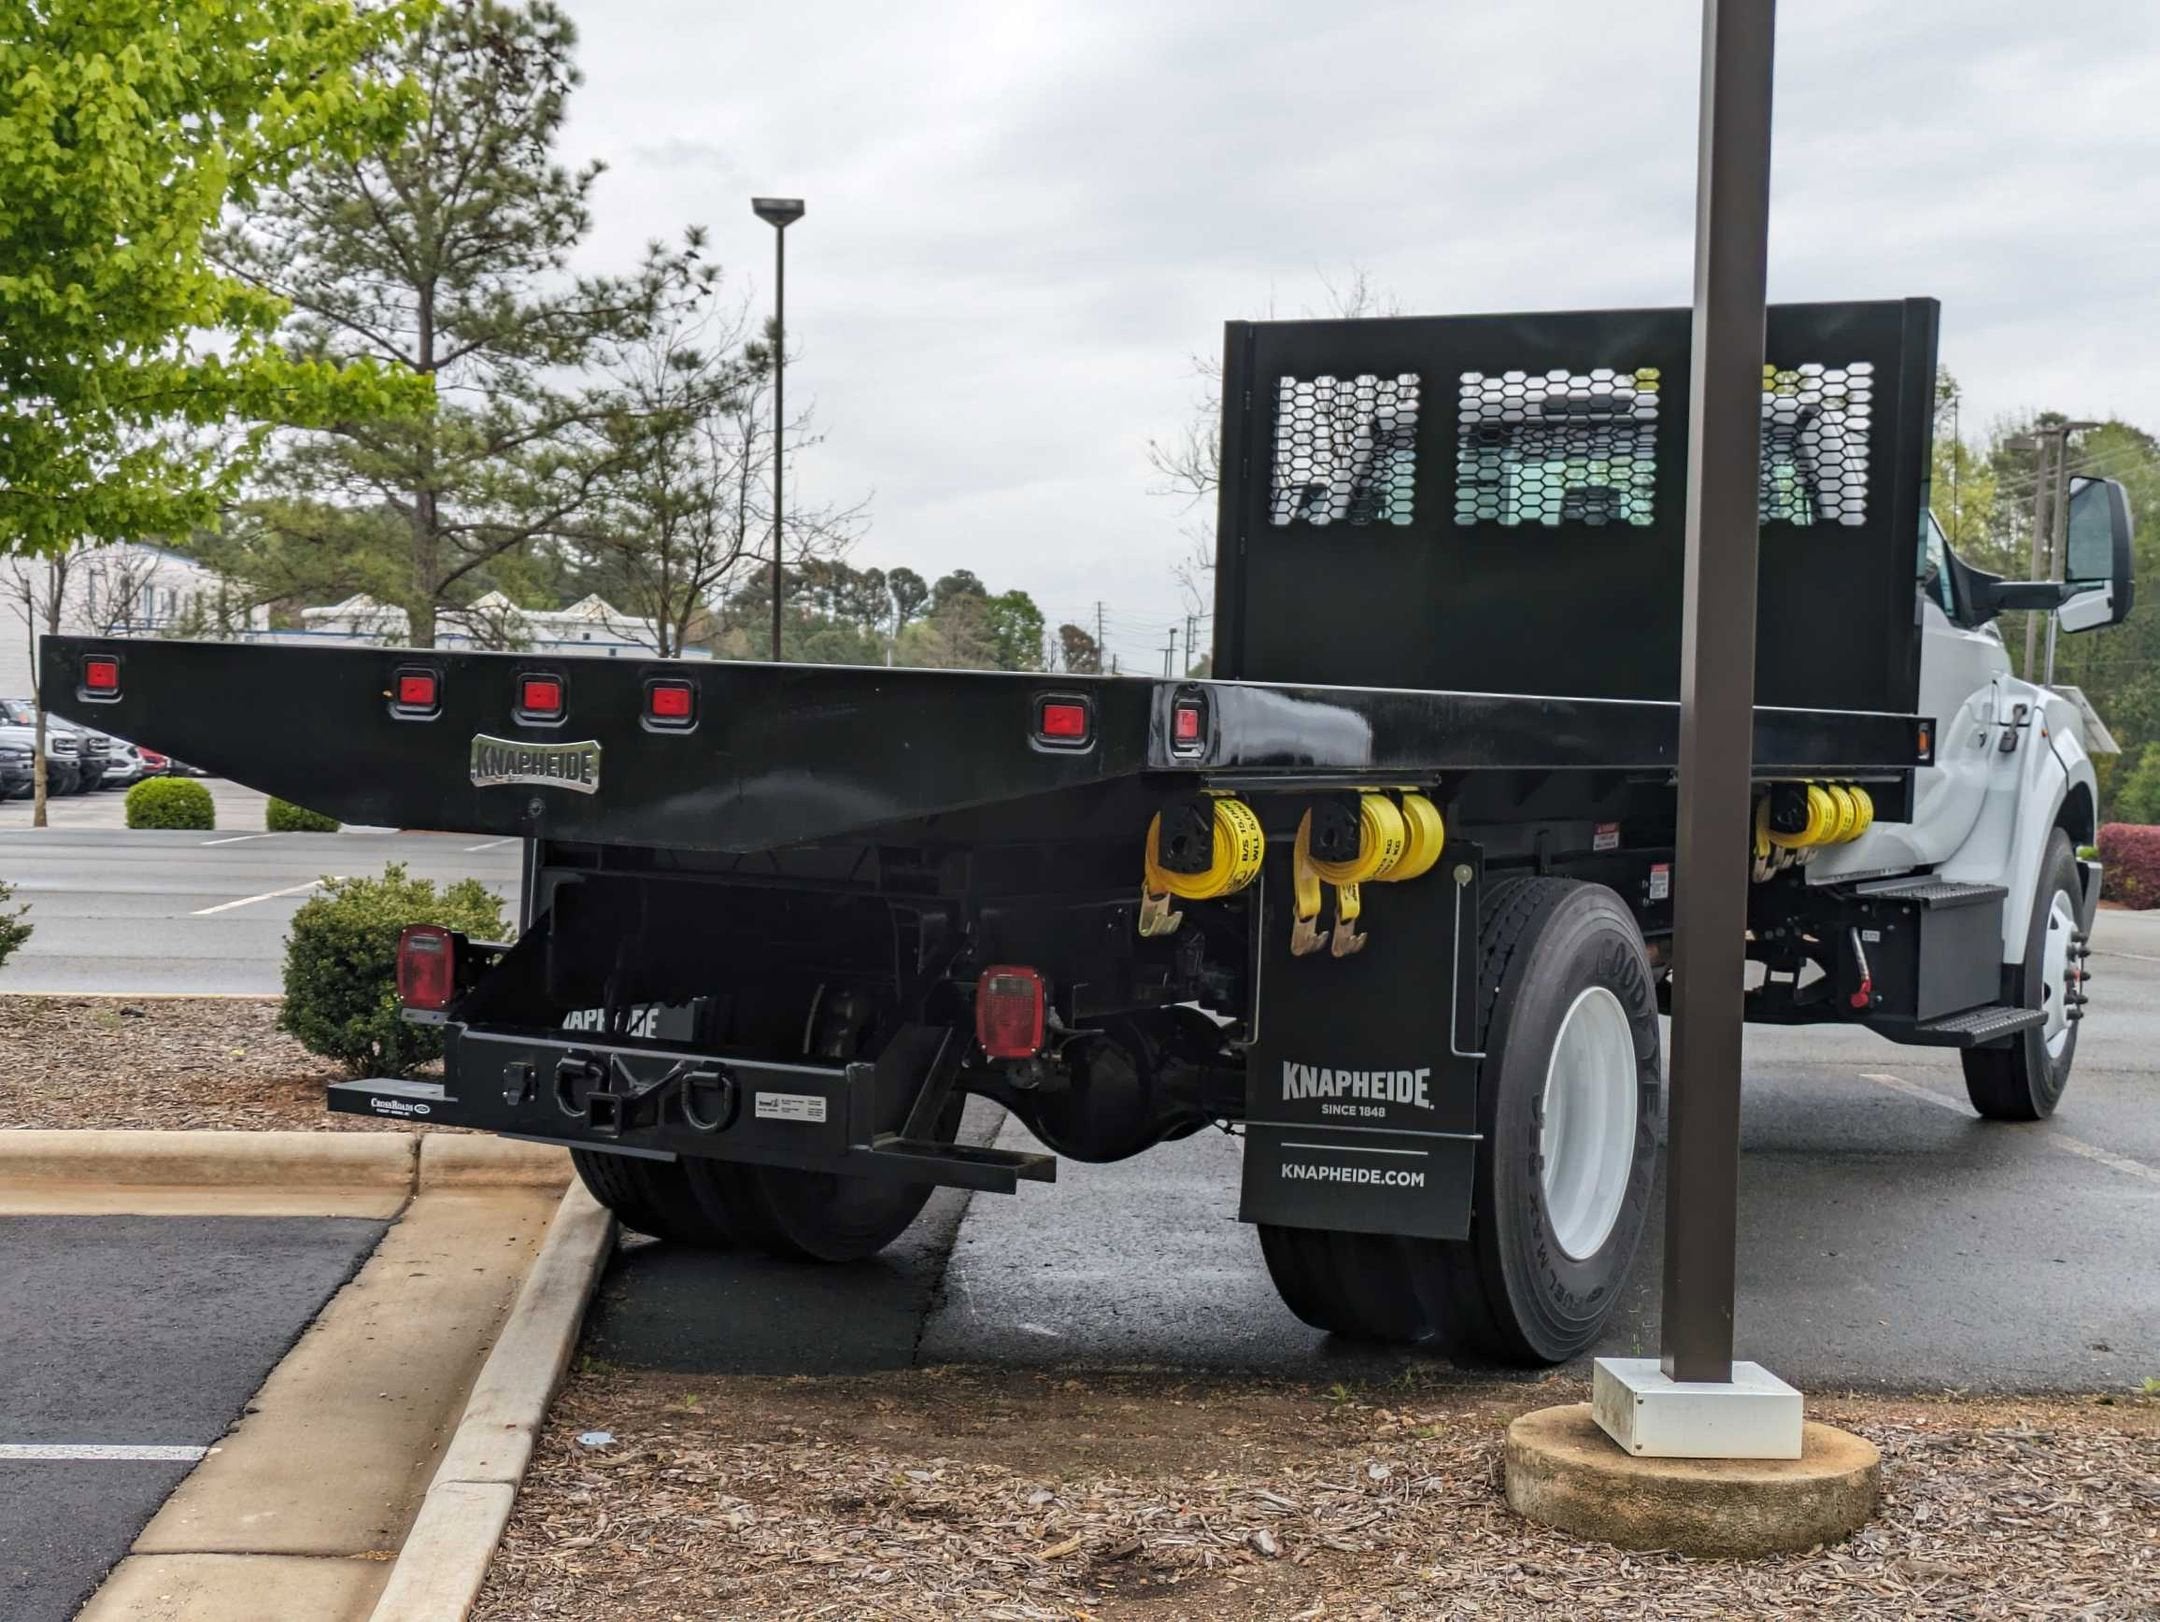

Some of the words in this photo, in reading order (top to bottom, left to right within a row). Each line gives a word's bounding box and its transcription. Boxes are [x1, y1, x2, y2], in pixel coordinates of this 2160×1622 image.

[478, 745, 594, 785] KNAPHEIDE
[1321, 1104, 1356, 1116] SINCE
[1359, 1106, 1386, 1118] 1848
[1281, 1163, 1425, 1187] KNAPHEIDE.COM
